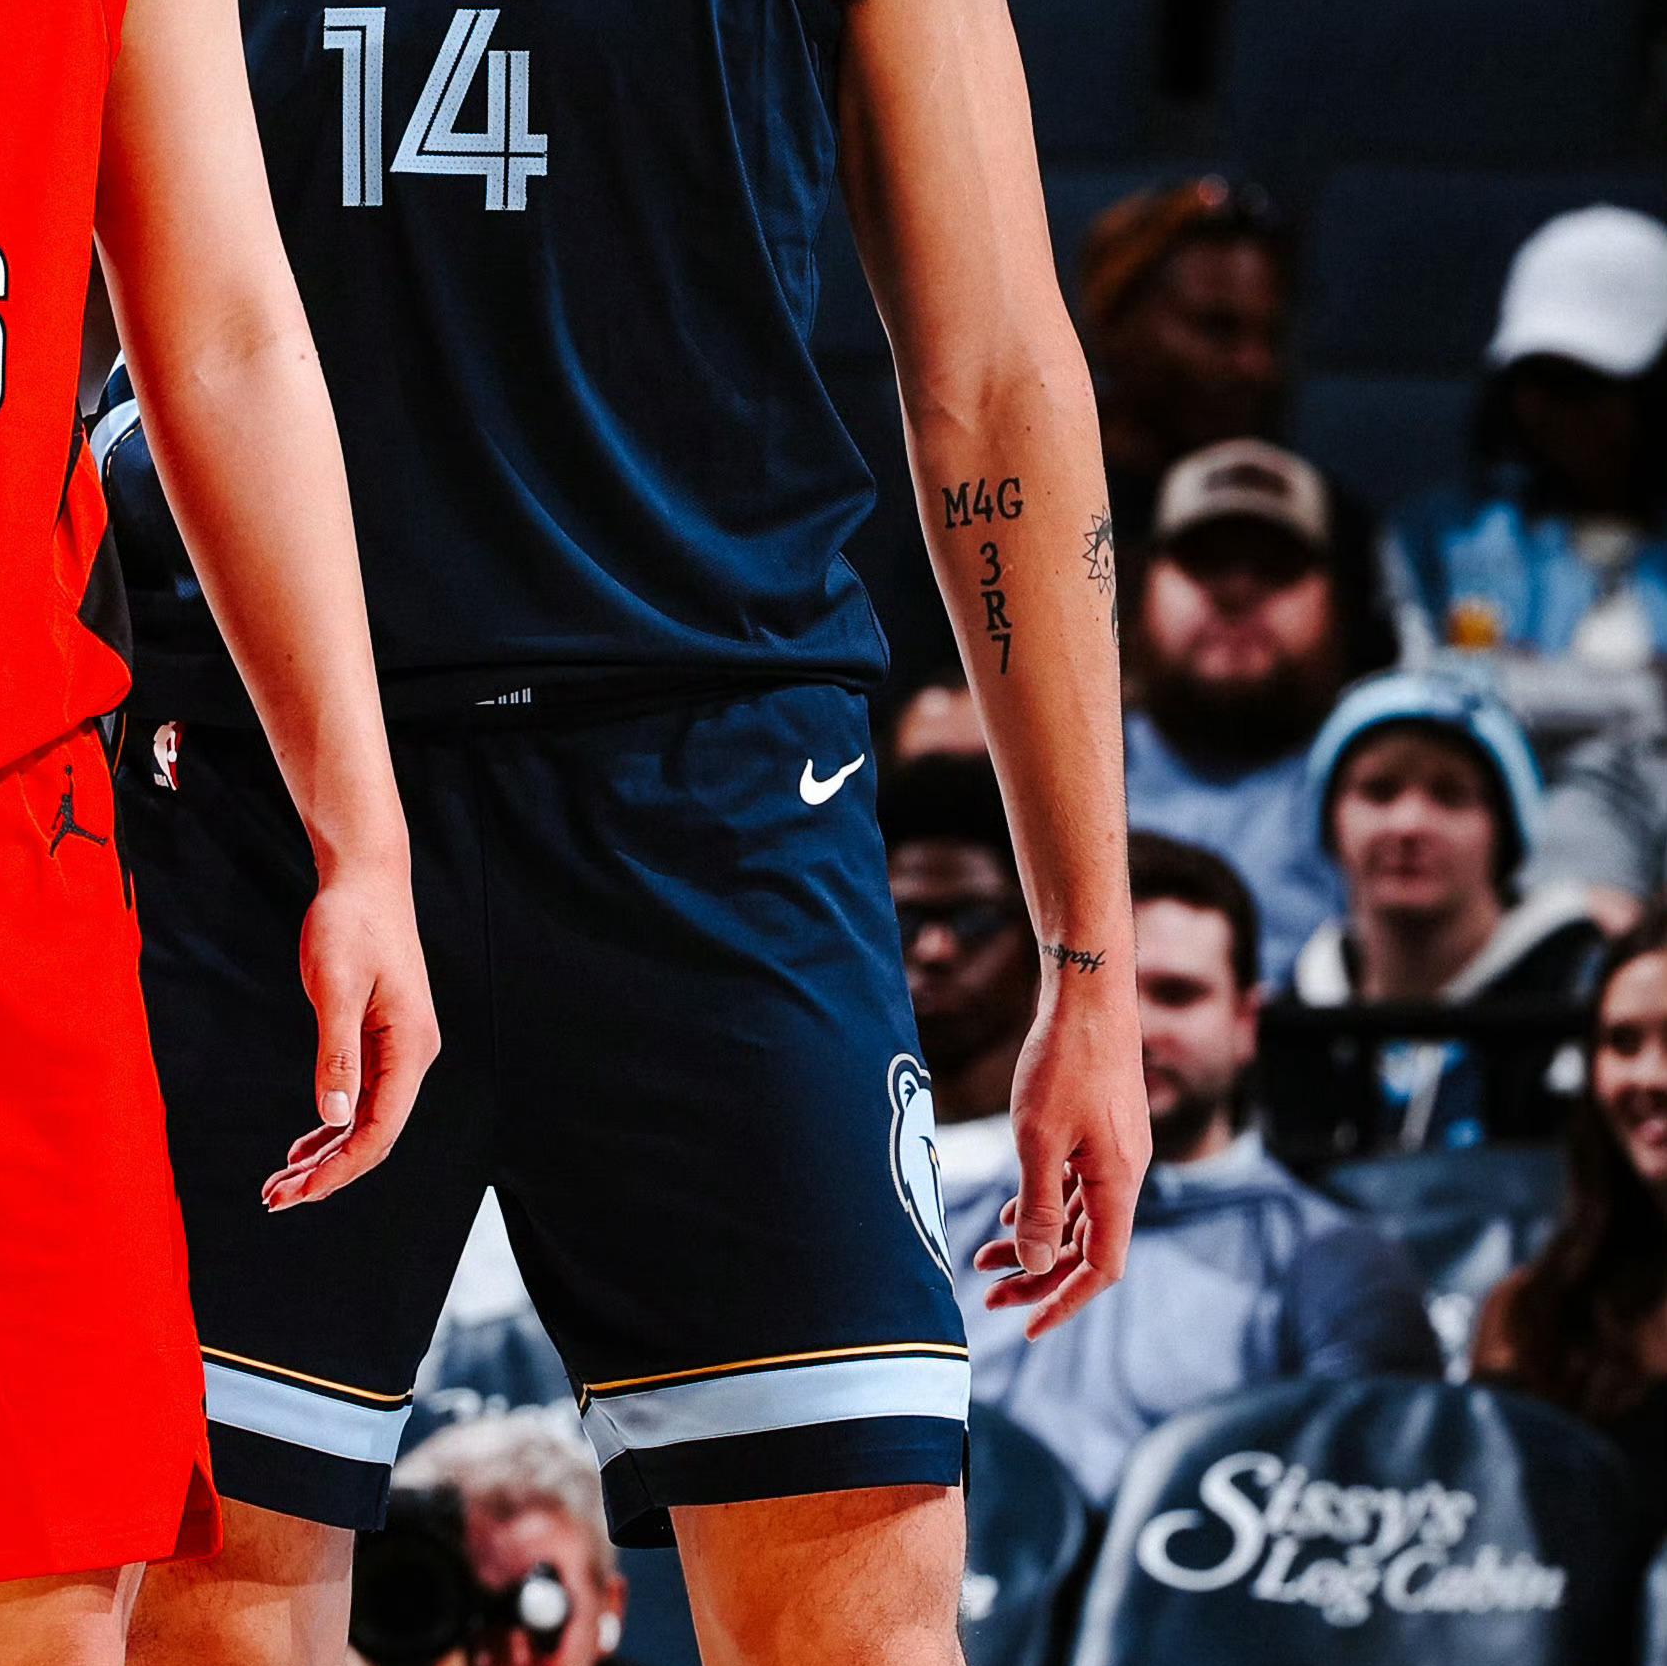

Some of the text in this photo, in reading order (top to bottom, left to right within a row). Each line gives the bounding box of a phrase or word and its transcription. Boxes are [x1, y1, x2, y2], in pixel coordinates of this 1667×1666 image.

[322, 6, 548, 211] 14
[941, 477, 1024, 529] M4G
[980, 541, 1002, 586] 3
[981, 589, 1013, 631] R
[991, 633, 1011, 675] 7
[1137, 1450, 1477, 1592] Sissy's
[1253, 1536, 1567, 1627] Log Cabin
